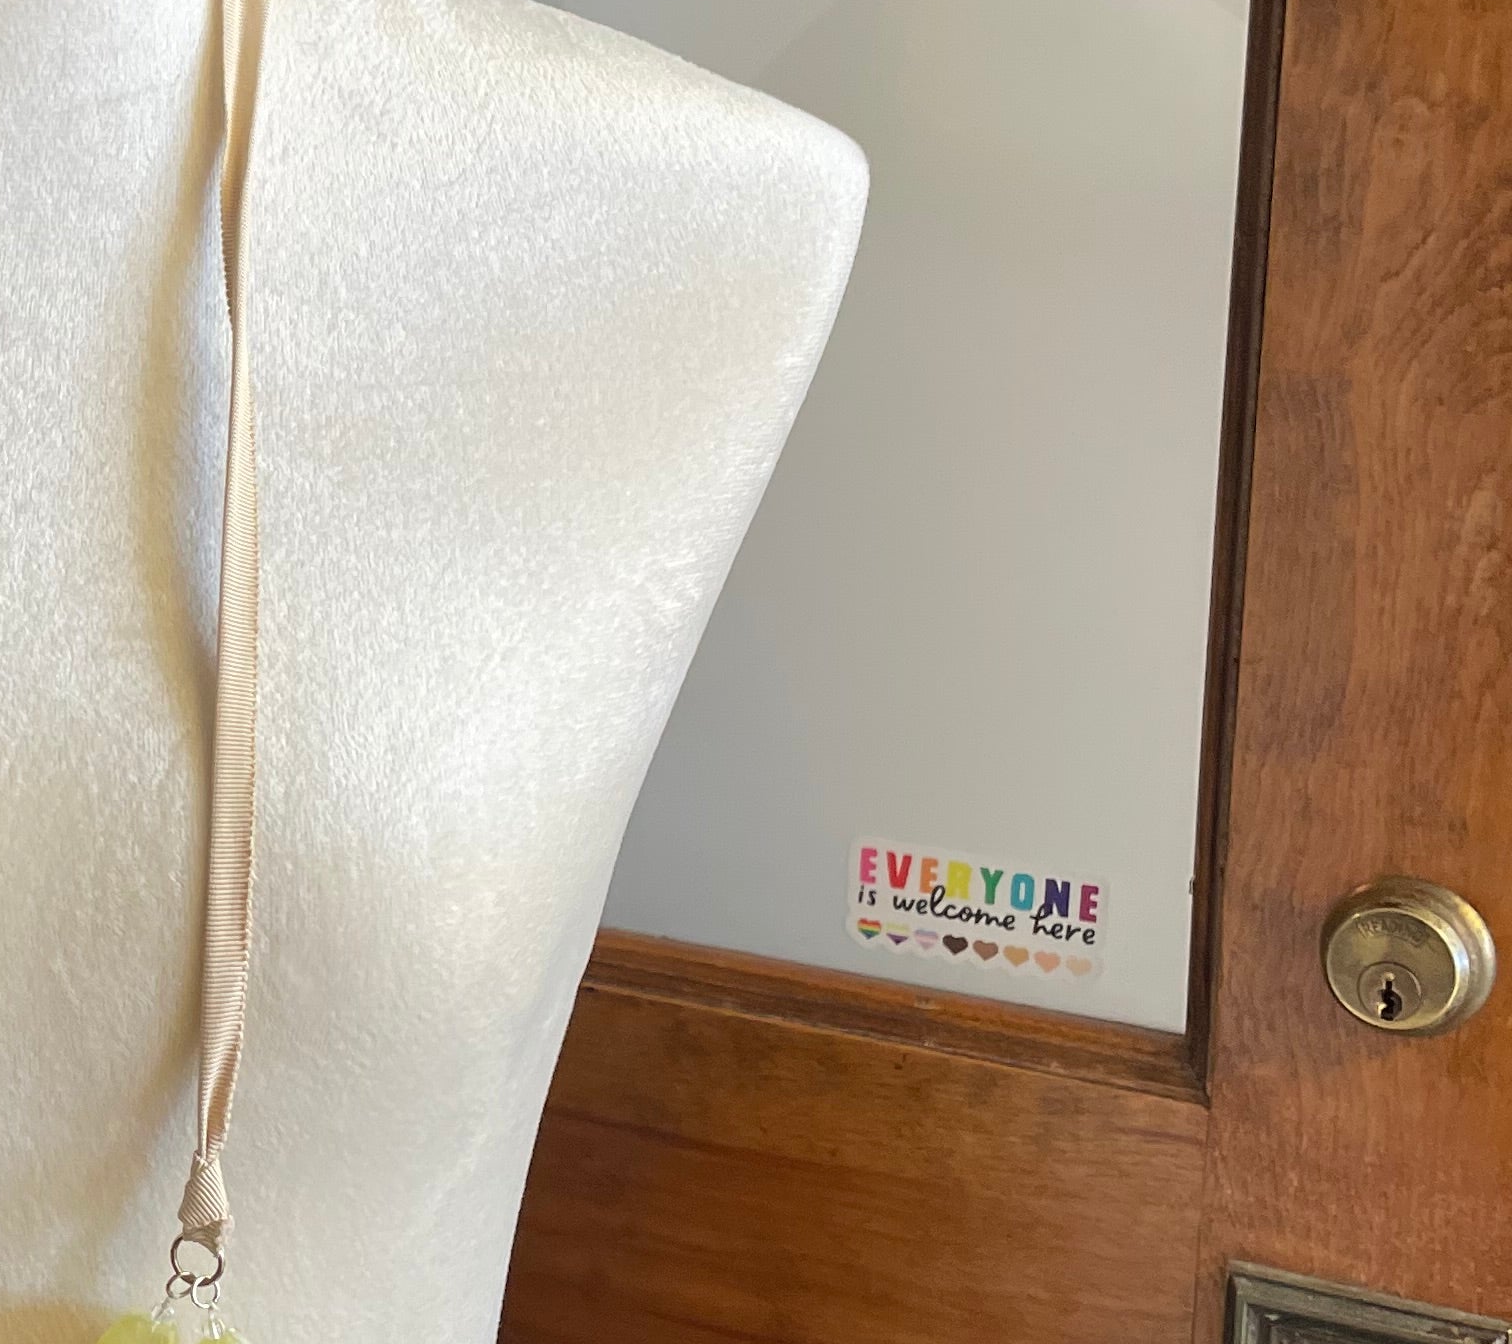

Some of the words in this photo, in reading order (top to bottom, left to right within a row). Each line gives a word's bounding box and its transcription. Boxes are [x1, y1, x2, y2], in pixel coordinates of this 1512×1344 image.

[857, 885, 877, 906] is
[892, 885, 1016, 931] welcome
[1029, 903, 1096, 945] here
[858, 847, 1099, 923] EVERYONE
